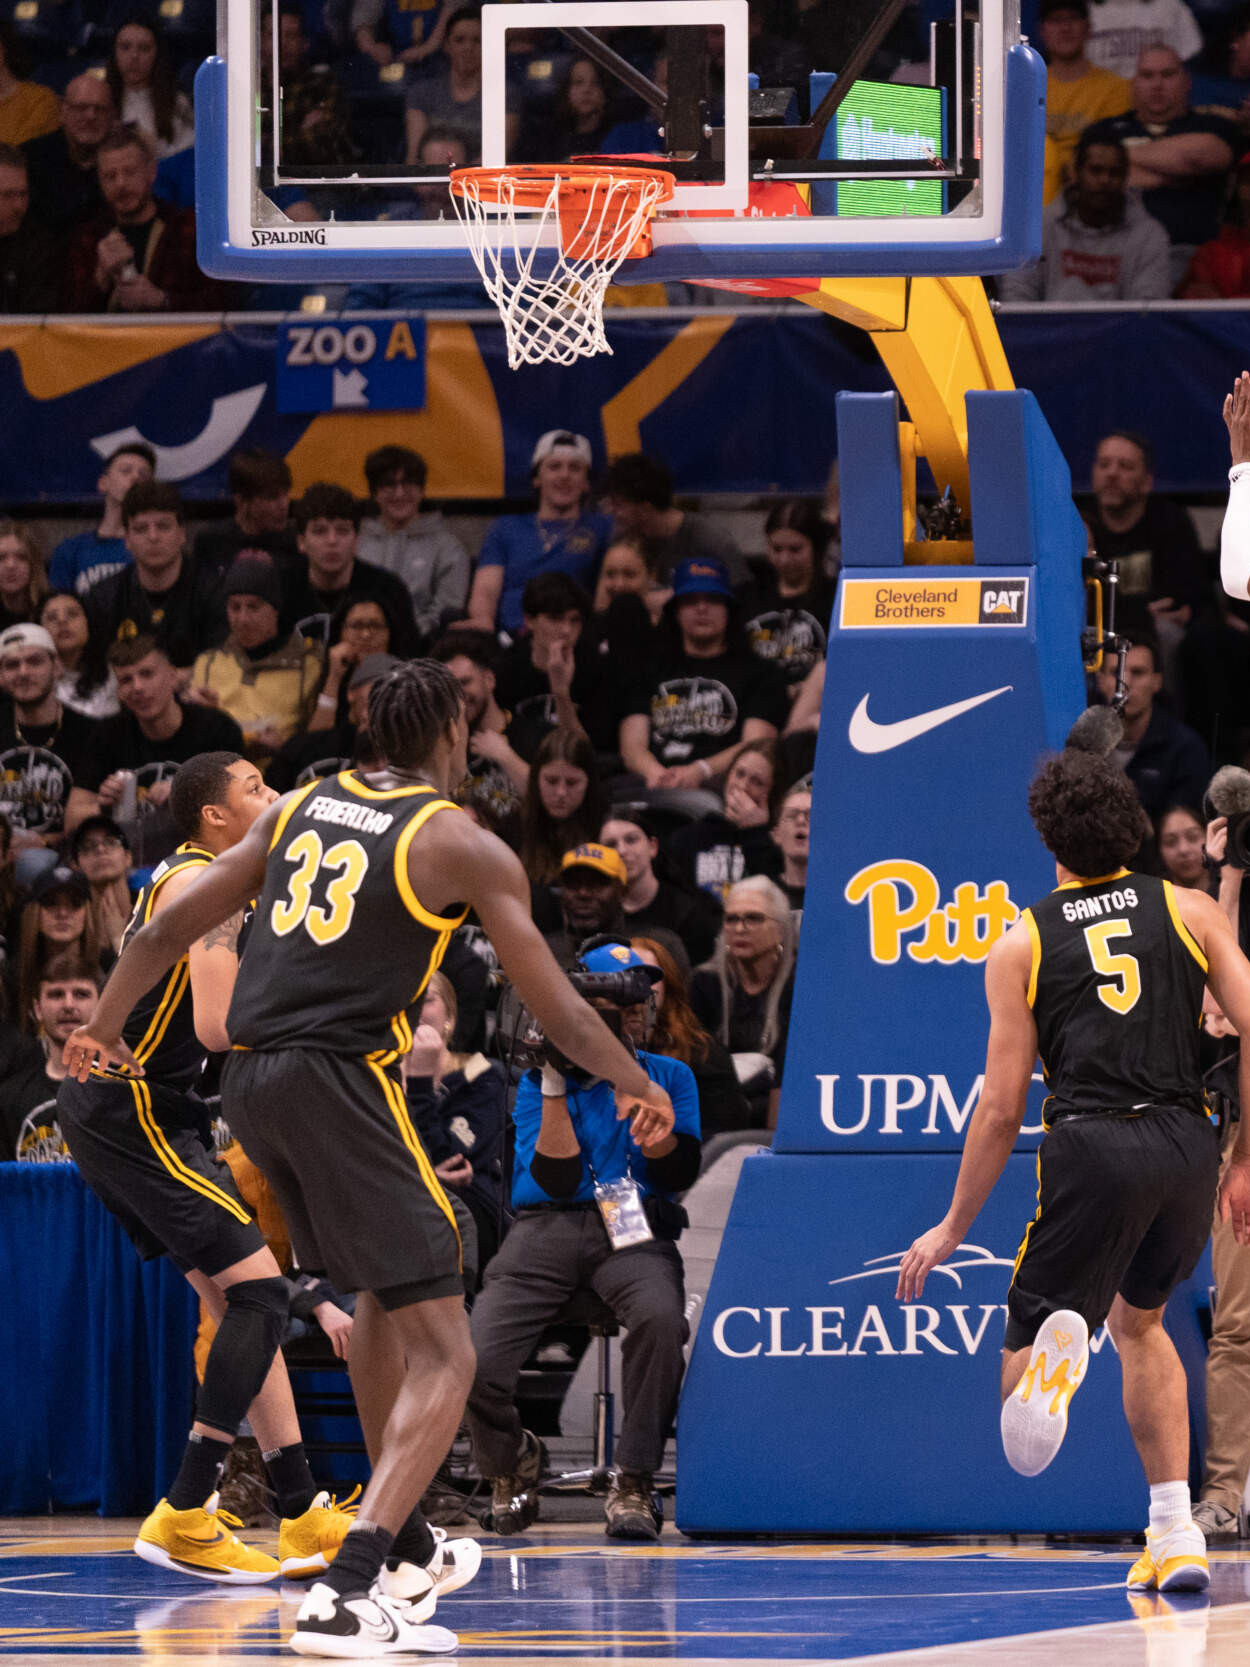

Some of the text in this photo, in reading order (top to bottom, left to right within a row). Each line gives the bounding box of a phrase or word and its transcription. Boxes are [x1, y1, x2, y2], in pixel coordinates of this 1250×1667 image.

[252, 228, 326, 247] SPALDING
[286, 320, 418, 366] ZOO A
[874, 603, 946, 618] Brothers
[875, 588, 958, 603] Cleveland
[983, 590, 1022, 613] CAT
[271, 829, 369, 946] 33
[1062, 887, 1139, 922] SANTOS
[844, 858, 1020, 965] Pitt
[1083, 918, 1141, 1016] 5
[712, 1304, 1118, 1358] CLEARV
